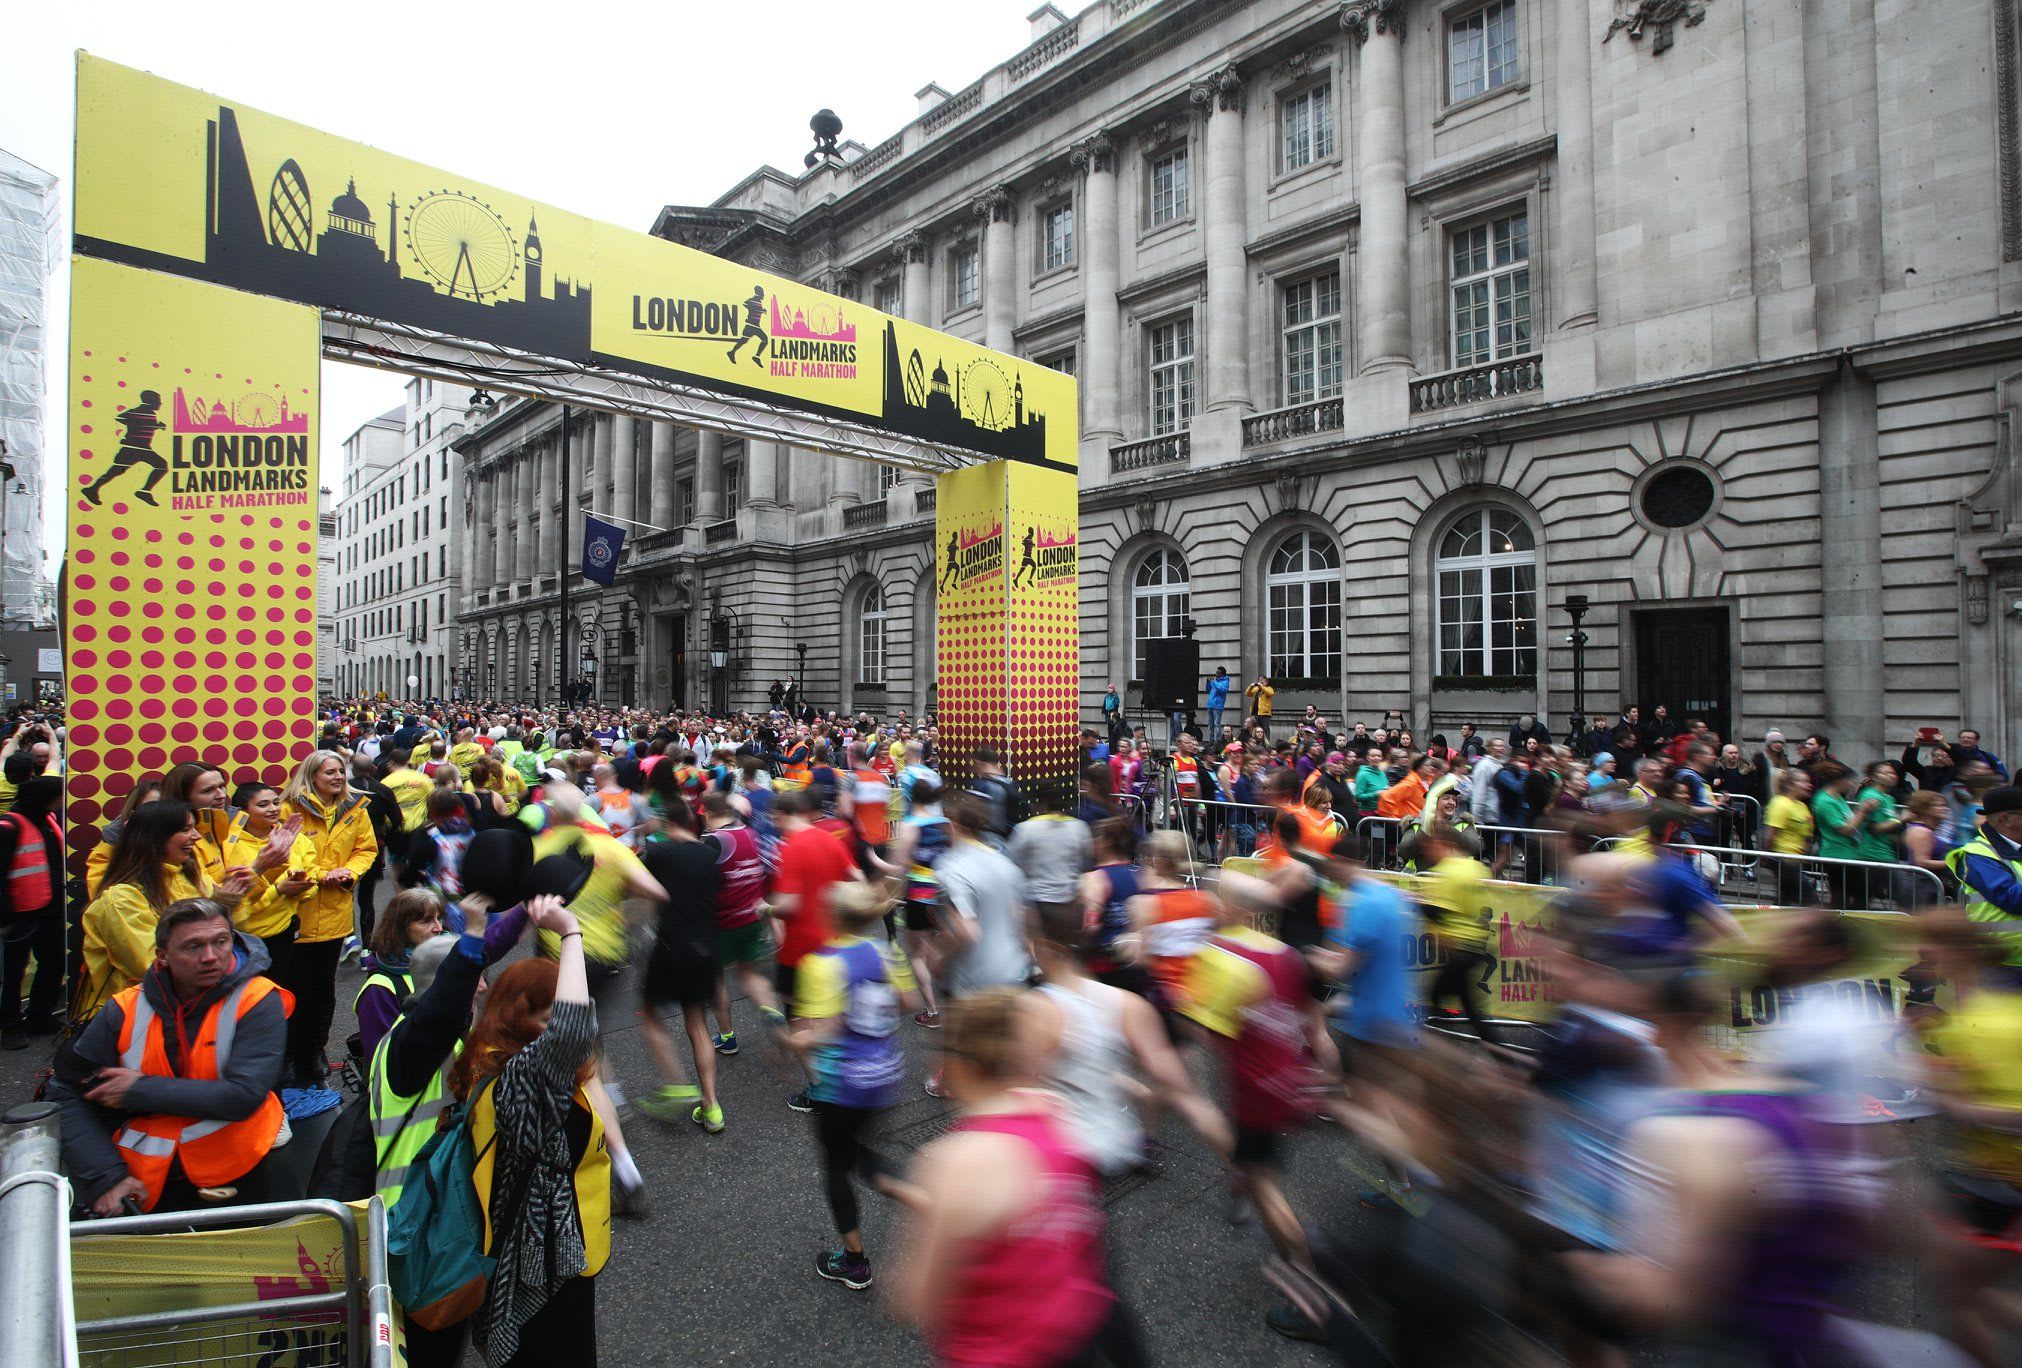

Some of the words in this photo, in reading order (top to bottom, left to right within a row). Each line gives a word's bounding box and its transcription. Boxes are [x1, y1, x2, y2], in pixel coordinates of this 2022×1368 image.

[632, 295, 738, 336] LONDON
[770, 339, 857, 363] LANDMARKS
[770, 361, 797, 377] HALF
[801, 362, 857, 379] MARATHON
[173, 435, 308, 468] LONDON
[172, 469, 308, 493] LANDMARKS
[172, 495, 215, 510] HALF
[220, 491, 308, 508] MARATHON
[960, 535, 1002, 568] LONDON
[1037, 546, 1076, 567] LONDON
[960, 555, 1002, 581] LANDMARKS
[961, 579, 973, 590] HALF
[974, 568, 1003, 586] MARATHON
[1037, 564, 1076, 581] LANDMARKS
[1038, 580, 1050, 589] HALF
[1051, 576, 1076, 588] MARATHON
[1501, 983, 1538, 1002] HALF
